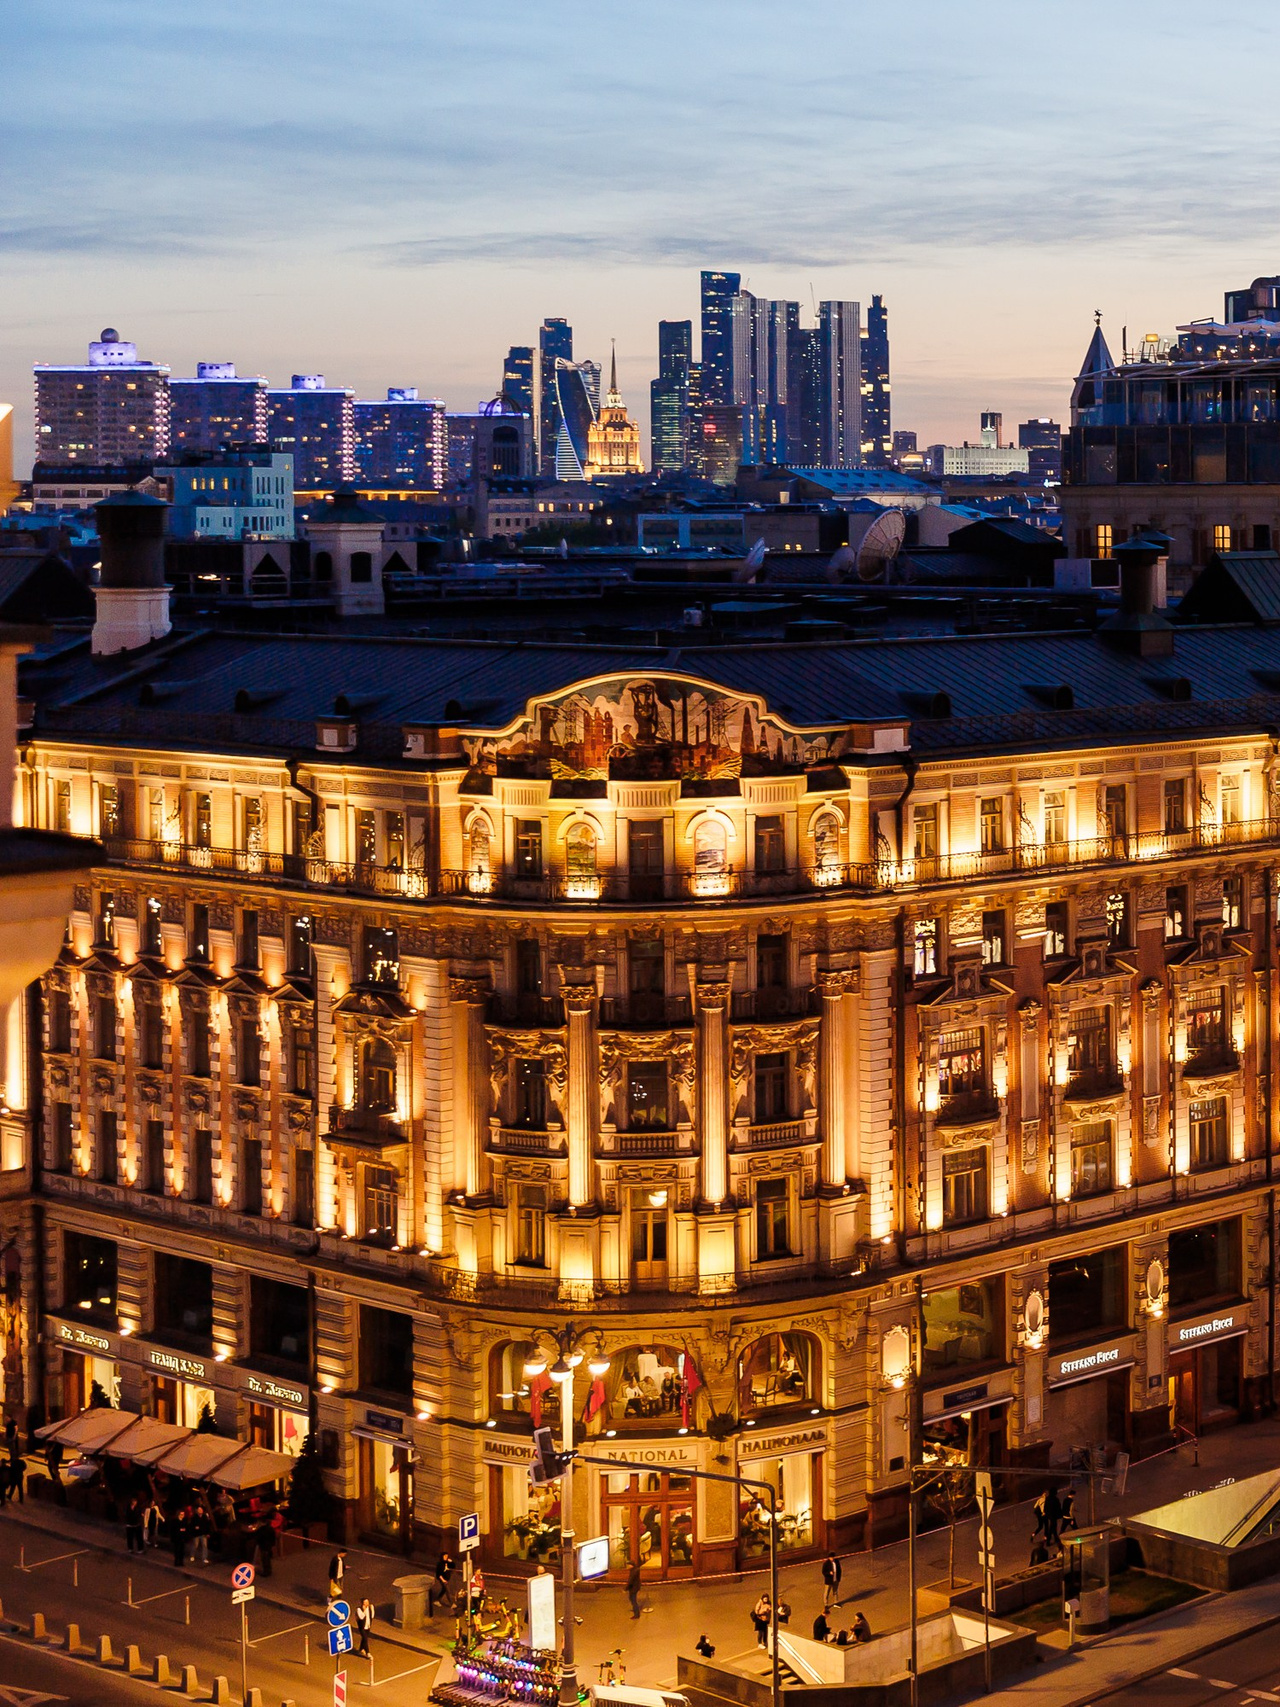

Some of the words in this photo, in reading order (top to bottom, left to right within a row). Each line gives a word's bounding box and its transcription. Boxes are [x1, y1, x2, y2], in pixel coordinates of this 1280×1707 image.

[1179, 1322, 1212, 1341] STEFANO
[1212, 1316, 1234, 1332] RICCI
[1060, 1354, 1096, 1374] STEFANO
[1096, 1347, 1119, 1364] RICCI
[484, 1440, 539, 1460] НАЦИОНА
[741, 1429, 826, 1455] НАЦИОНАЛЬ
[607, 1448, 688, 1463] NATIONAL
[463, 1517, 475, 1538] P
